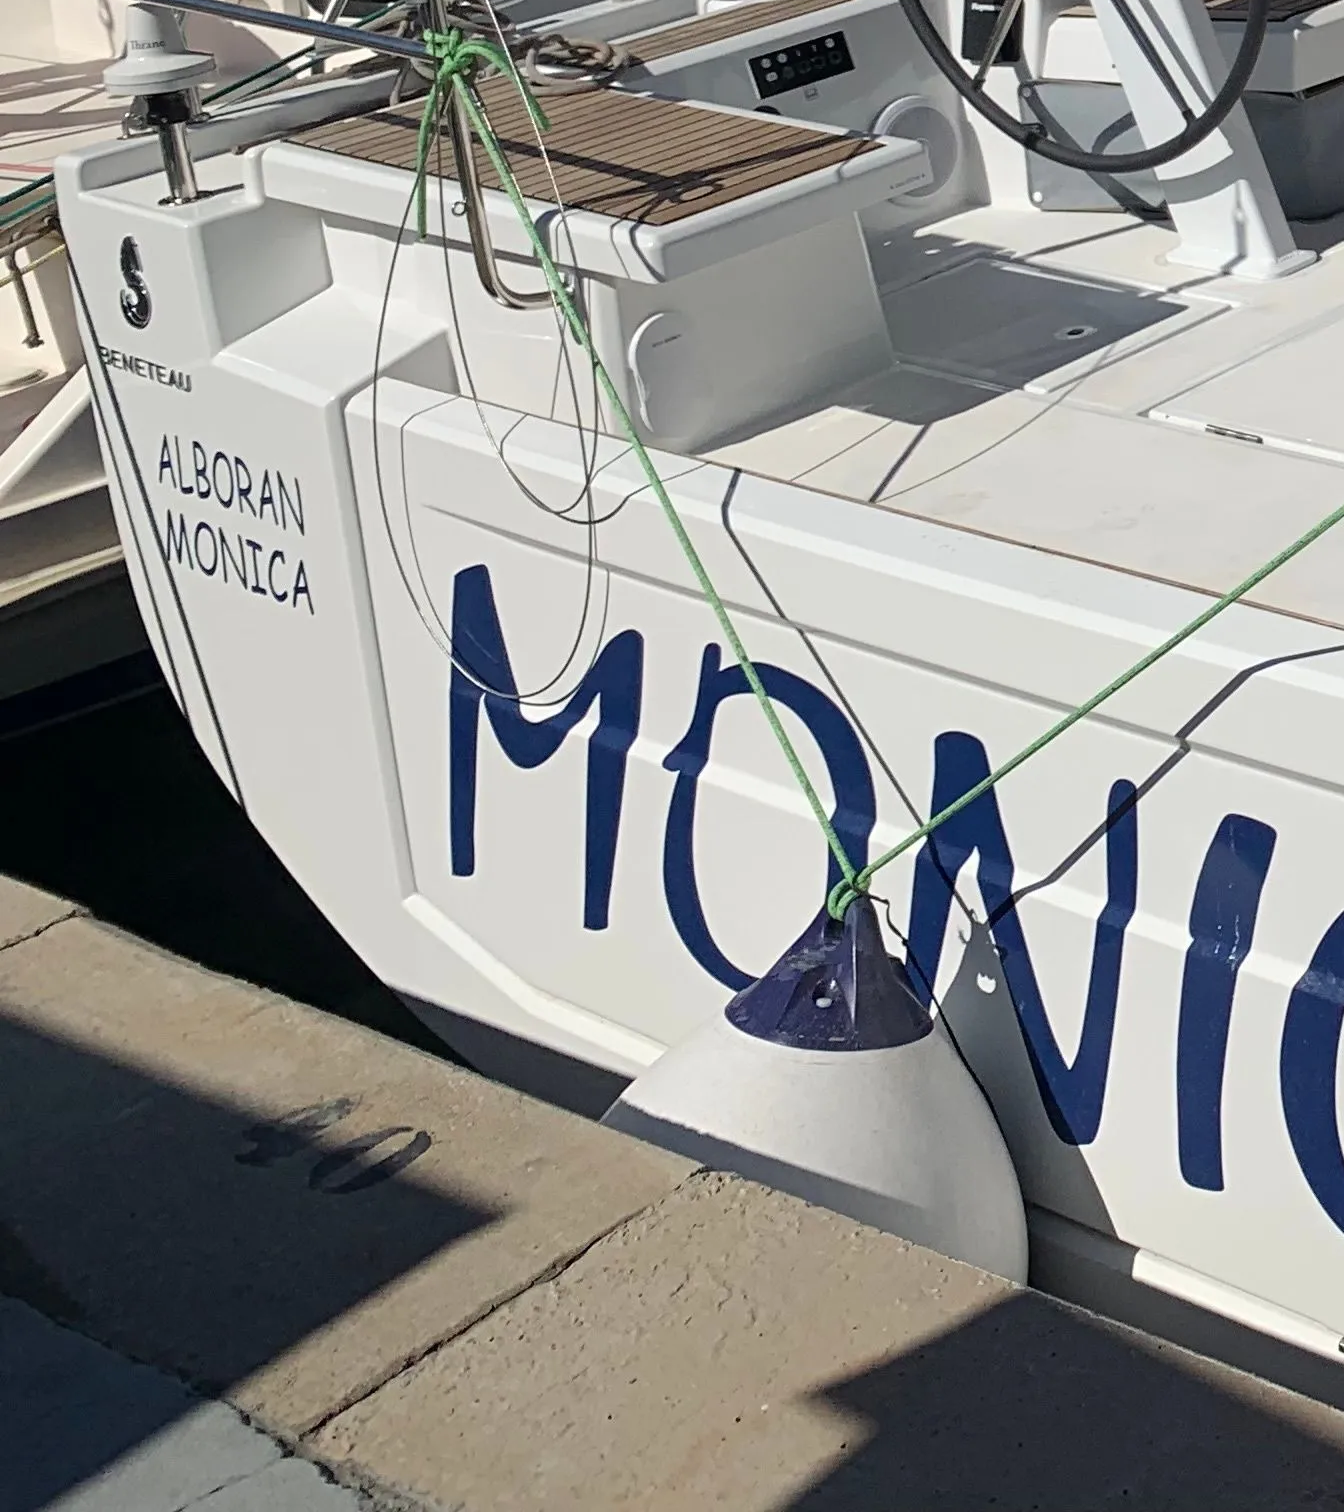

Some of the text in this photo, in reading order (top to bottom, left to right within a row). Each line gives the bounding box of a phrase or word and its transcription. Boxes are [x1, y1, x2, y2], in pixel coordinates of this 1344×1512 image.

[99, 345, 193, 393] BENETEAU
[158, 433, 306, 537] ALBORAN
[164, 509, 315, 616] MONICA
